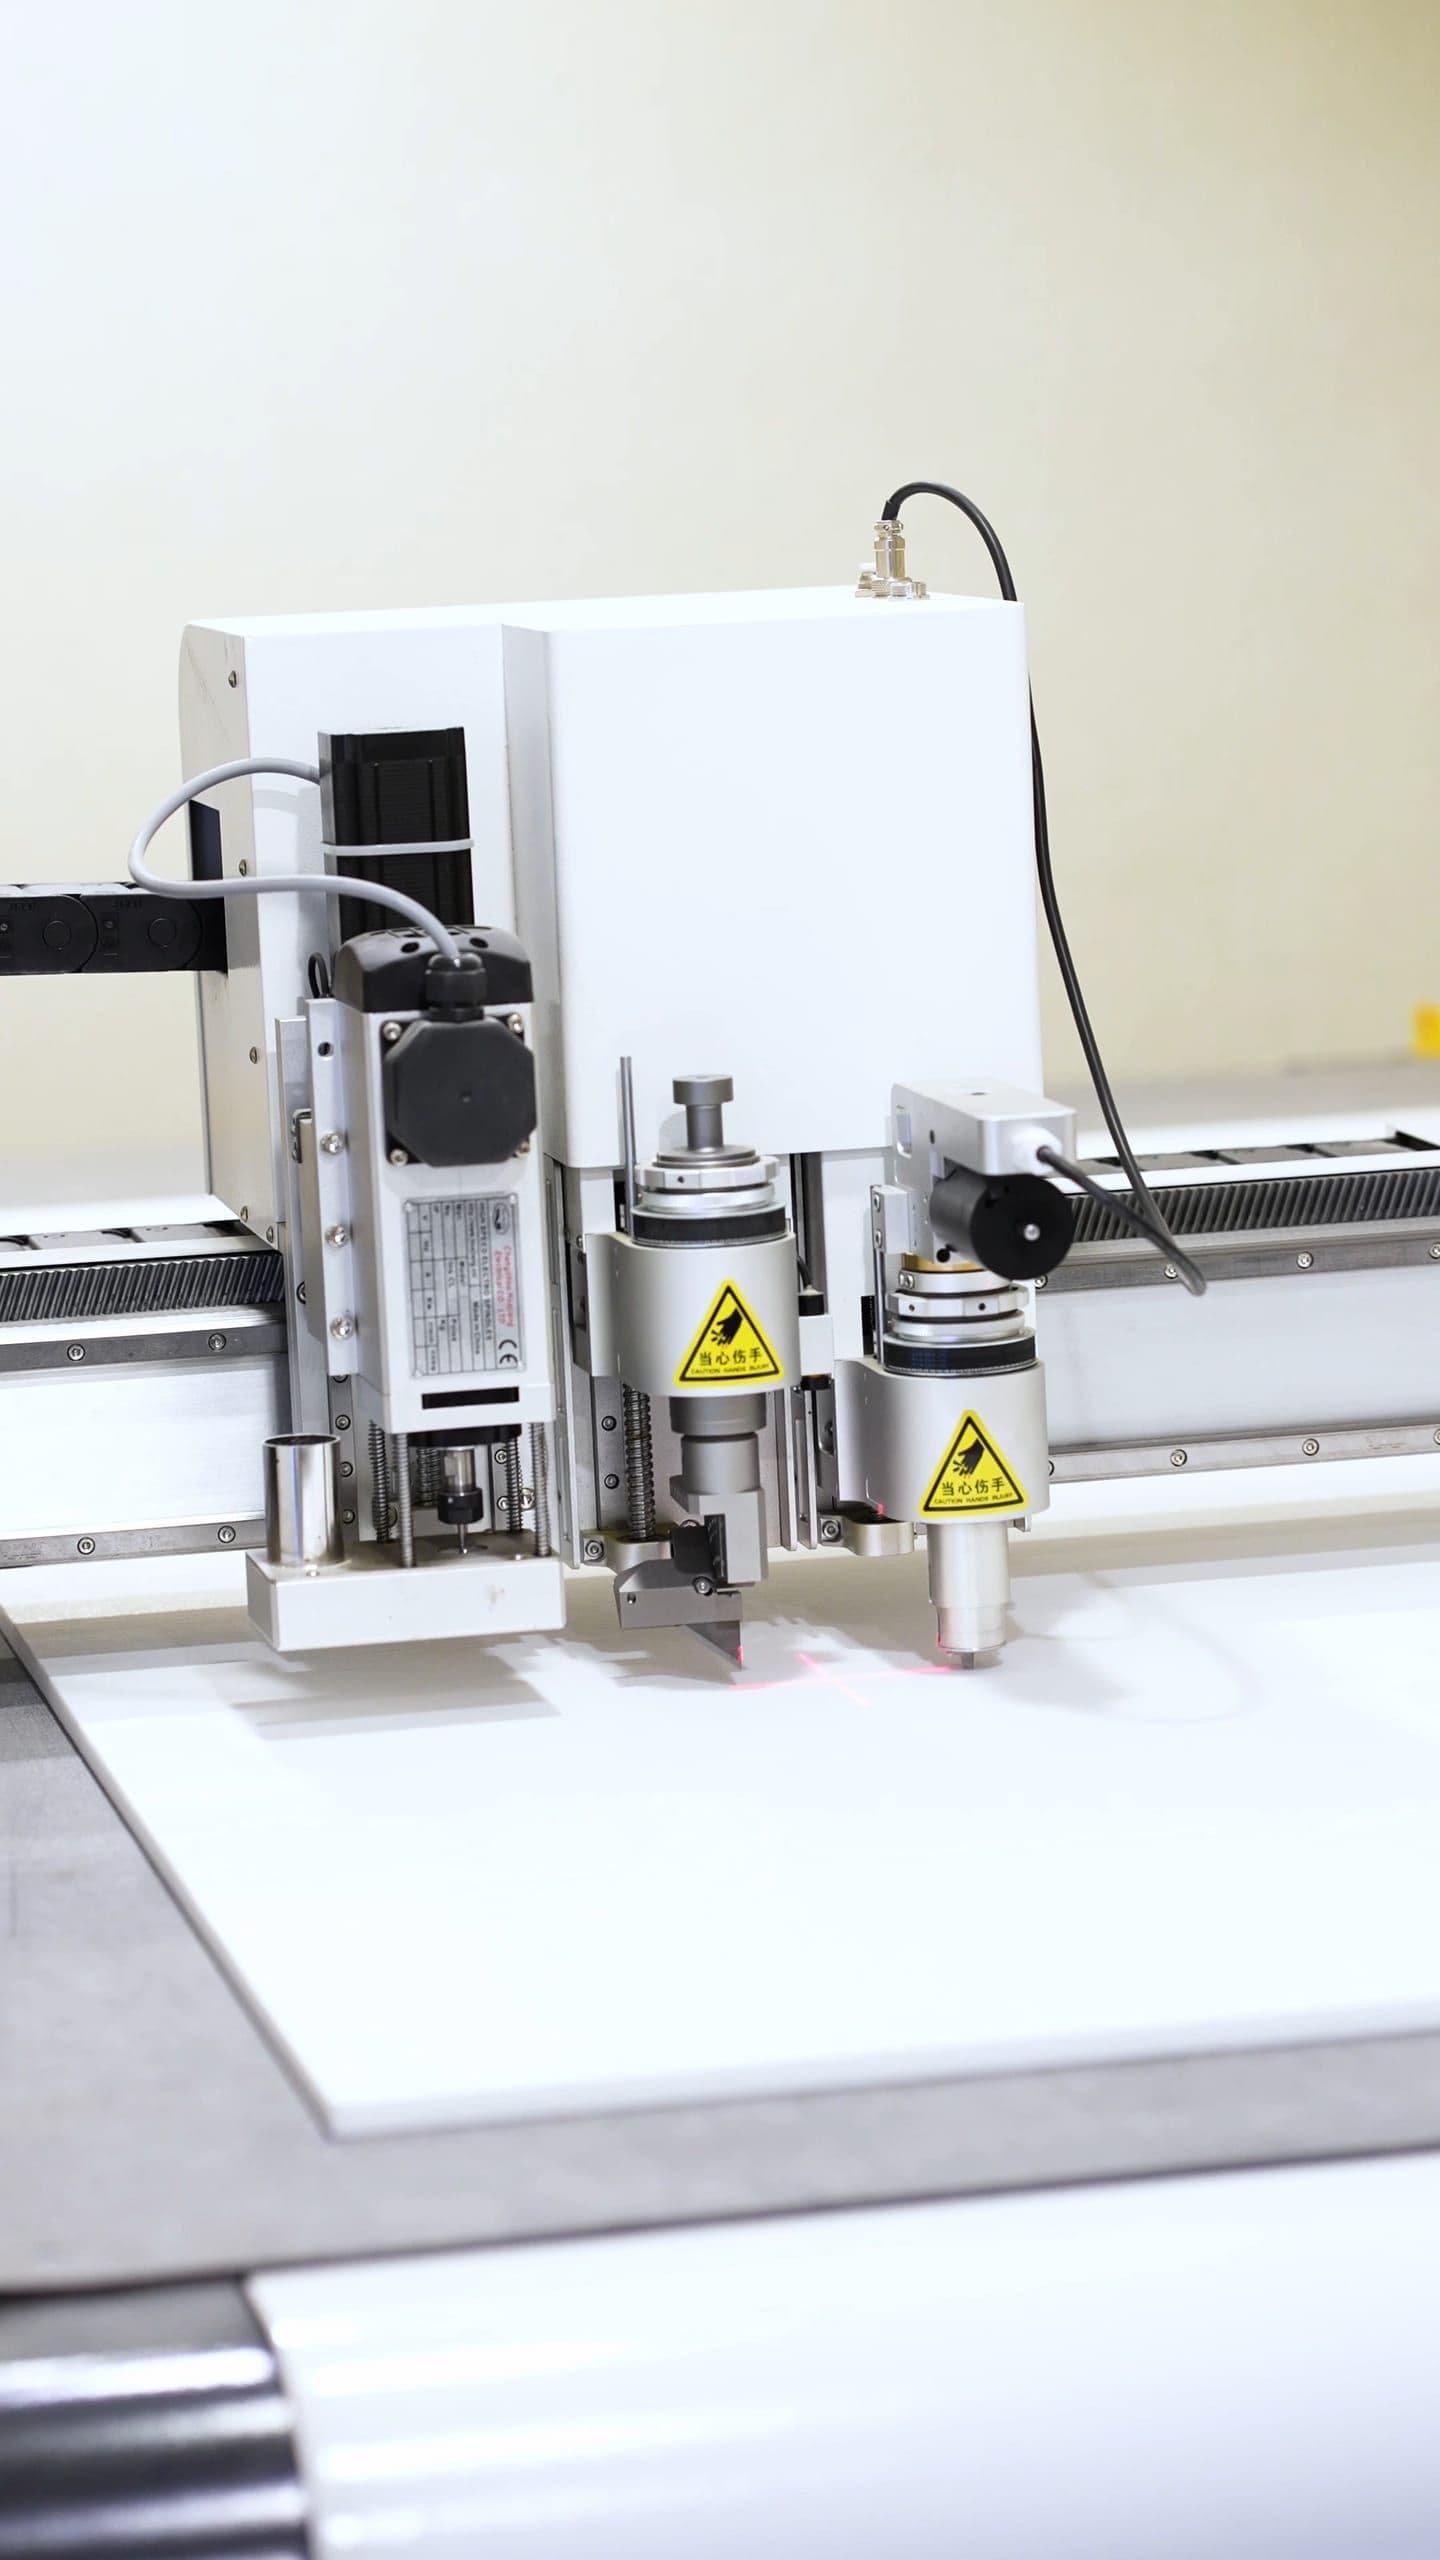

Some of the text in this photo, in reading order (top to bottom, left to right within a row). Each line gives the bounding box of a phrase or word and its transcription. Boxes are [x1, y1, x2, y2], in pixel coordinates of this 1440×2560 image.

[482, 1256, 490, 1296] ELECTRO
[499, 1340, 518, 1364] CE
[700, 1348, 762, 1366] 当心伤手
[942, 1477, 1005, 1496] 当心伤手
